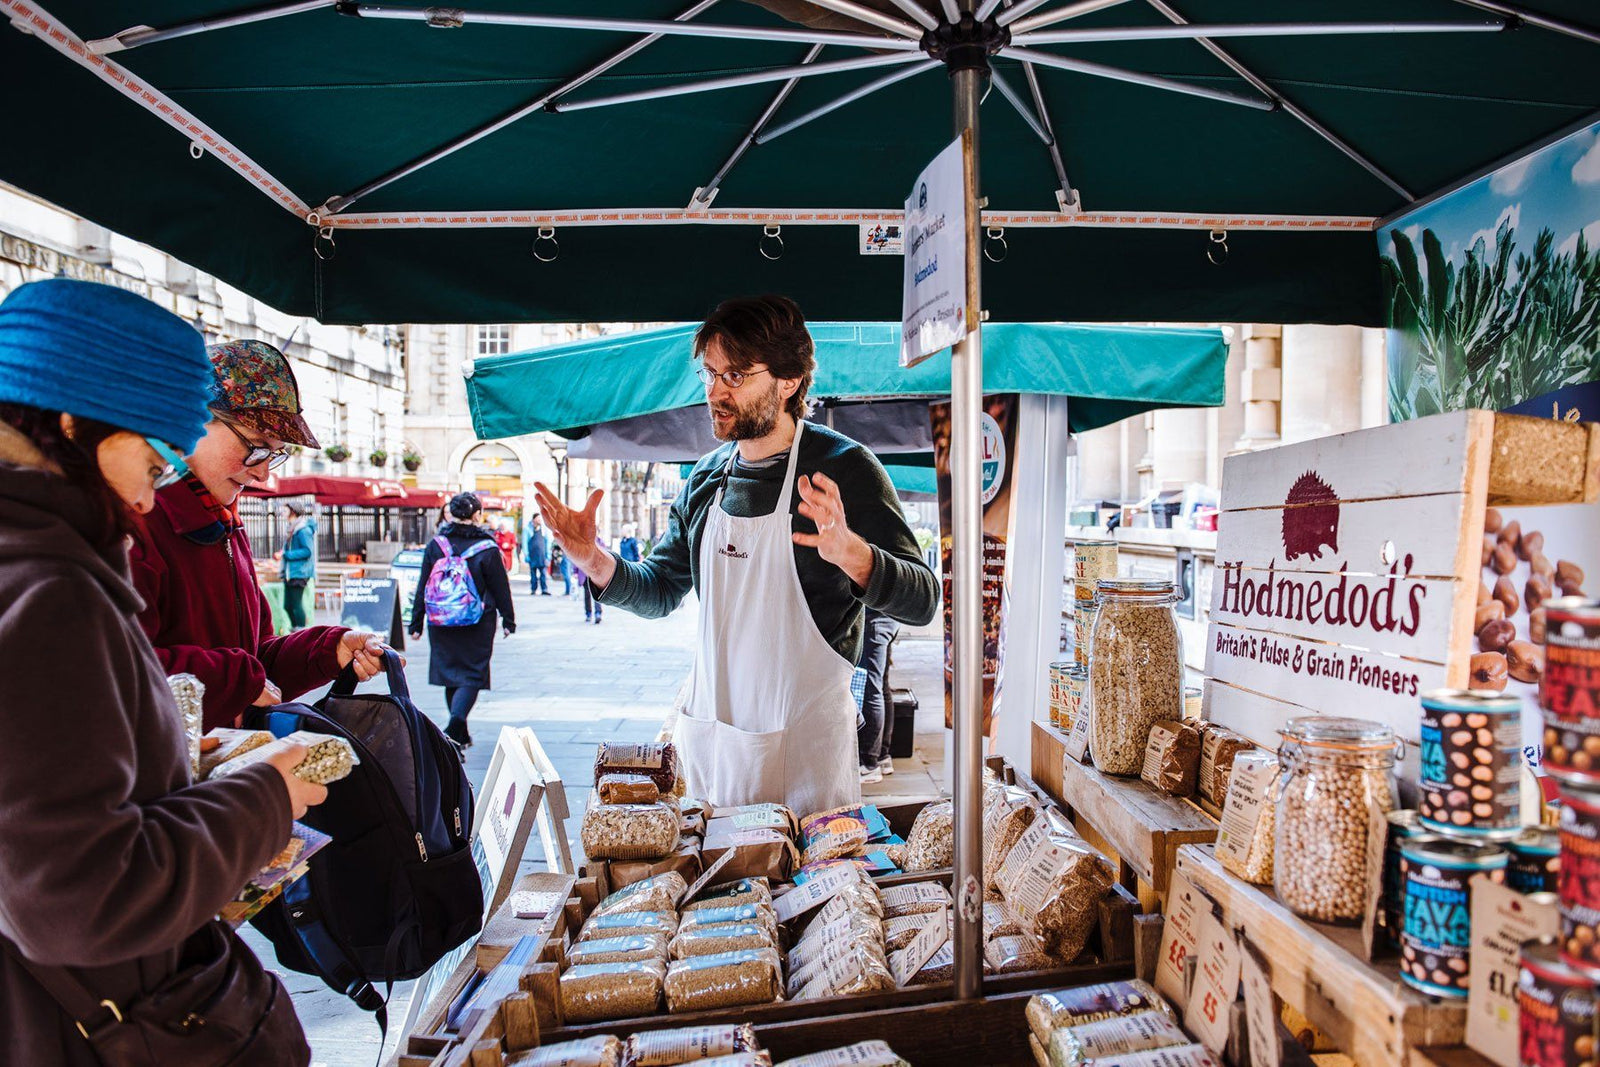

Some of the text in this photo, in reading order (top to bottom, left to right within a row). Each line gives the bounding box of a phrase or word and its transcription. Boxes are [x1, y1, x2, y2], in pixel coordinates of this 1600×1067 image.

[1220, 553, 1427, 637] Hodmedod's
[1216, 632, 1420, 697] Britain's Pulse & Grain Pioneers
[1405, 894, 1470, 929] FAVA
[1203, 991, 1218, 1024] £5
